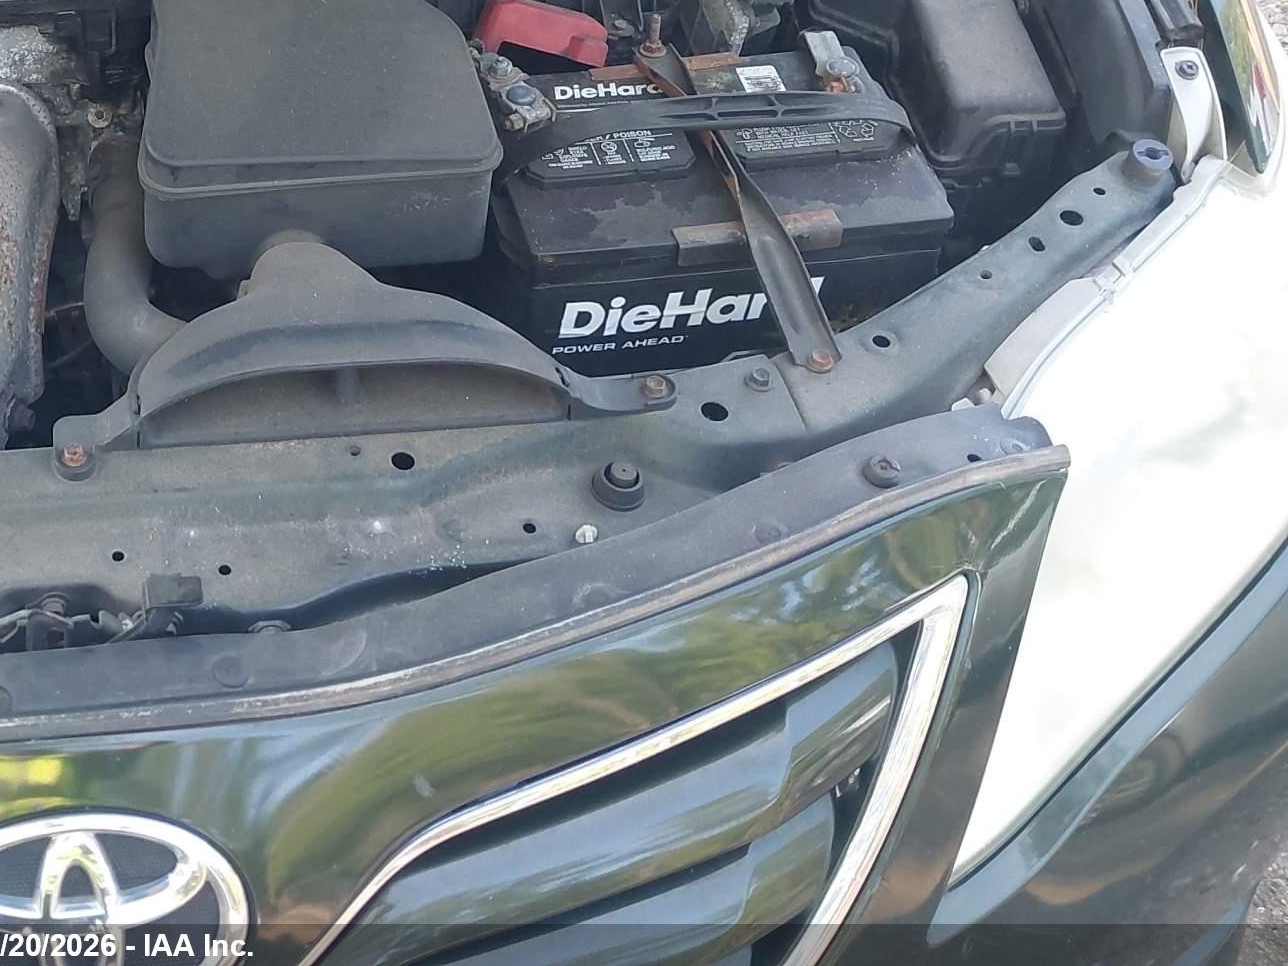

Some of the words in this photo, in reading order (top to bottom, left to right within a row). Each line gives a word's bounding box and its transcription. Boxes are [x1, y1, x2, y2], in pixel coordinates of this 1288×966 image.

[613, 130, 652, 139] POISON
[558, 276, 825, 339] DieHar
[552, 341, 616, 355] POWER
[621, 335, 685, 349] AHEAD
